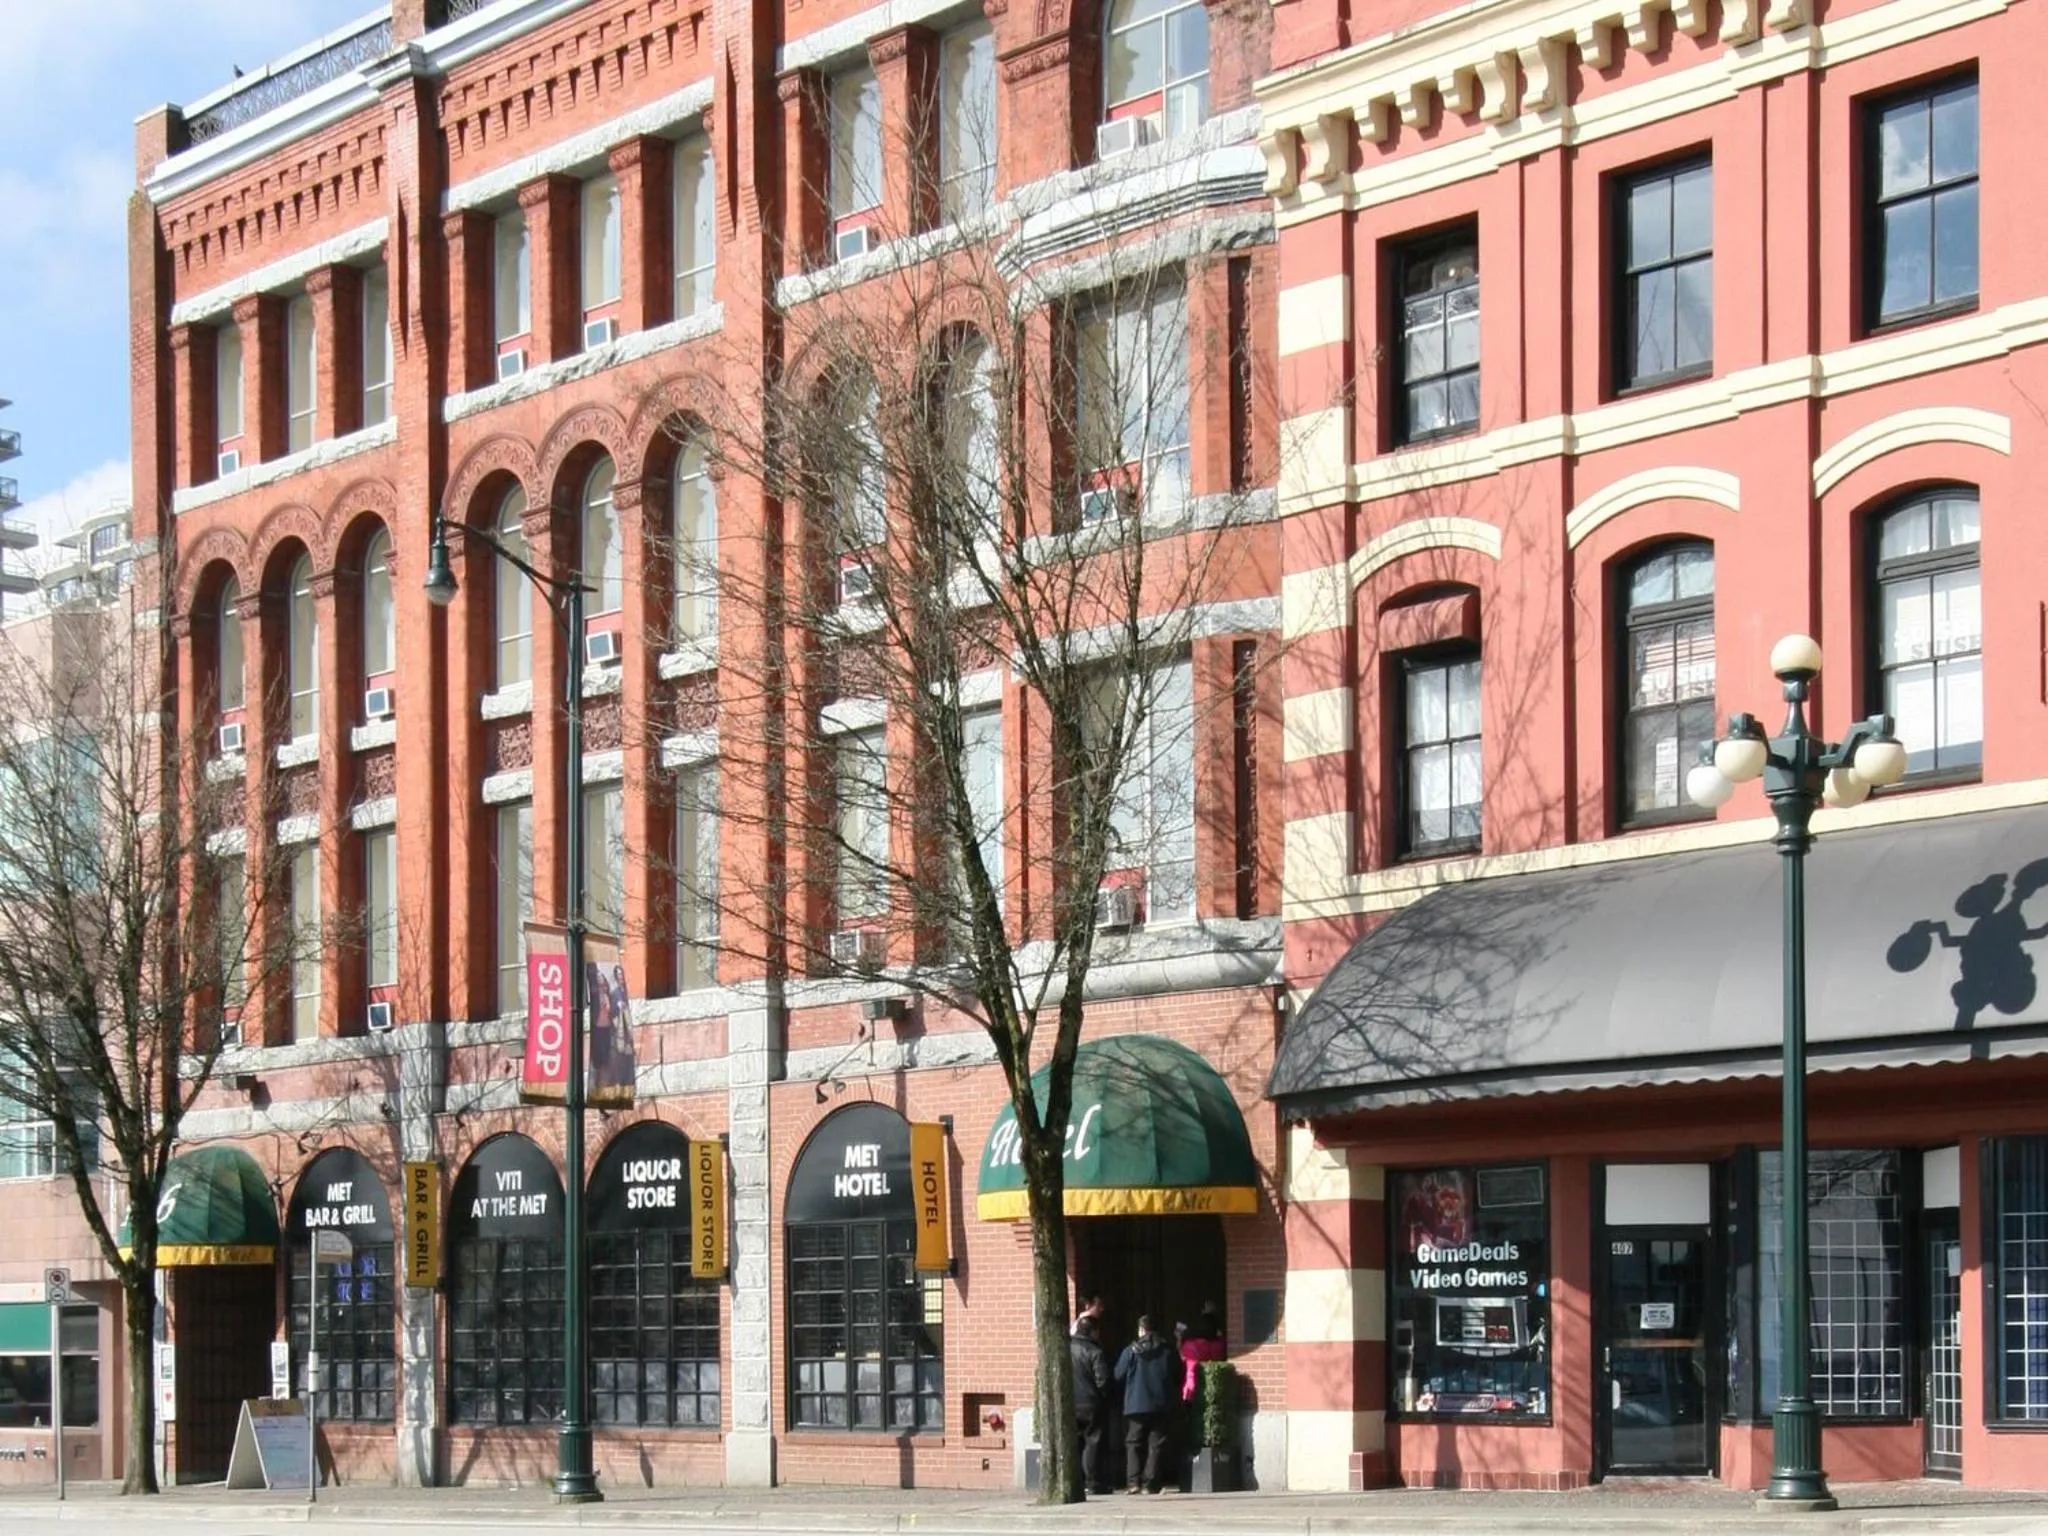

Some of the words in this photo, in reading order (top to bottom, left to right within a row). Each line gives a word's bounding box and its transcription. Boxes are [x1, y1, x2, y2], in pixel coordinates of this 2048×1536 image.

[536, 961, 564, 1077] SHOP
[989, 1103, 1102, 1168] Hel
[844, 1144, 881, 1168] MET
[622, 1158, 682, 1183] LIQUOR
[700, 1144, 714, 1210] LIQUOR
[327, 1182, 353, 1202] MET
[415, 1168, 429, 1204] BAR
[834, 1173, 891, 1197] HOTEL
[921, 1161, 938, 1229] HOTEL
[470, 1198, 489, 1218] AT
[491, 1196, 517, 1217] THE
[519, 1194, 547, 1215] MET
[627, 1186, 676, 1209] STORE
[305, 1208, 330, 1227] BAR
[331, 1207, 340, 1226] &
[343, 1204, 376, 1225] GRILL
[416, 1210, 428, 1222] &
[416, 1228, 429, 1277] GRILL
[702, 1216, 714, 1270] STORE
[1417, 1241, 1520, 1263] GameDeals
[1410, 1268, 1462, 1289] Video
[1464, 1267, 1529, 1288] Games
